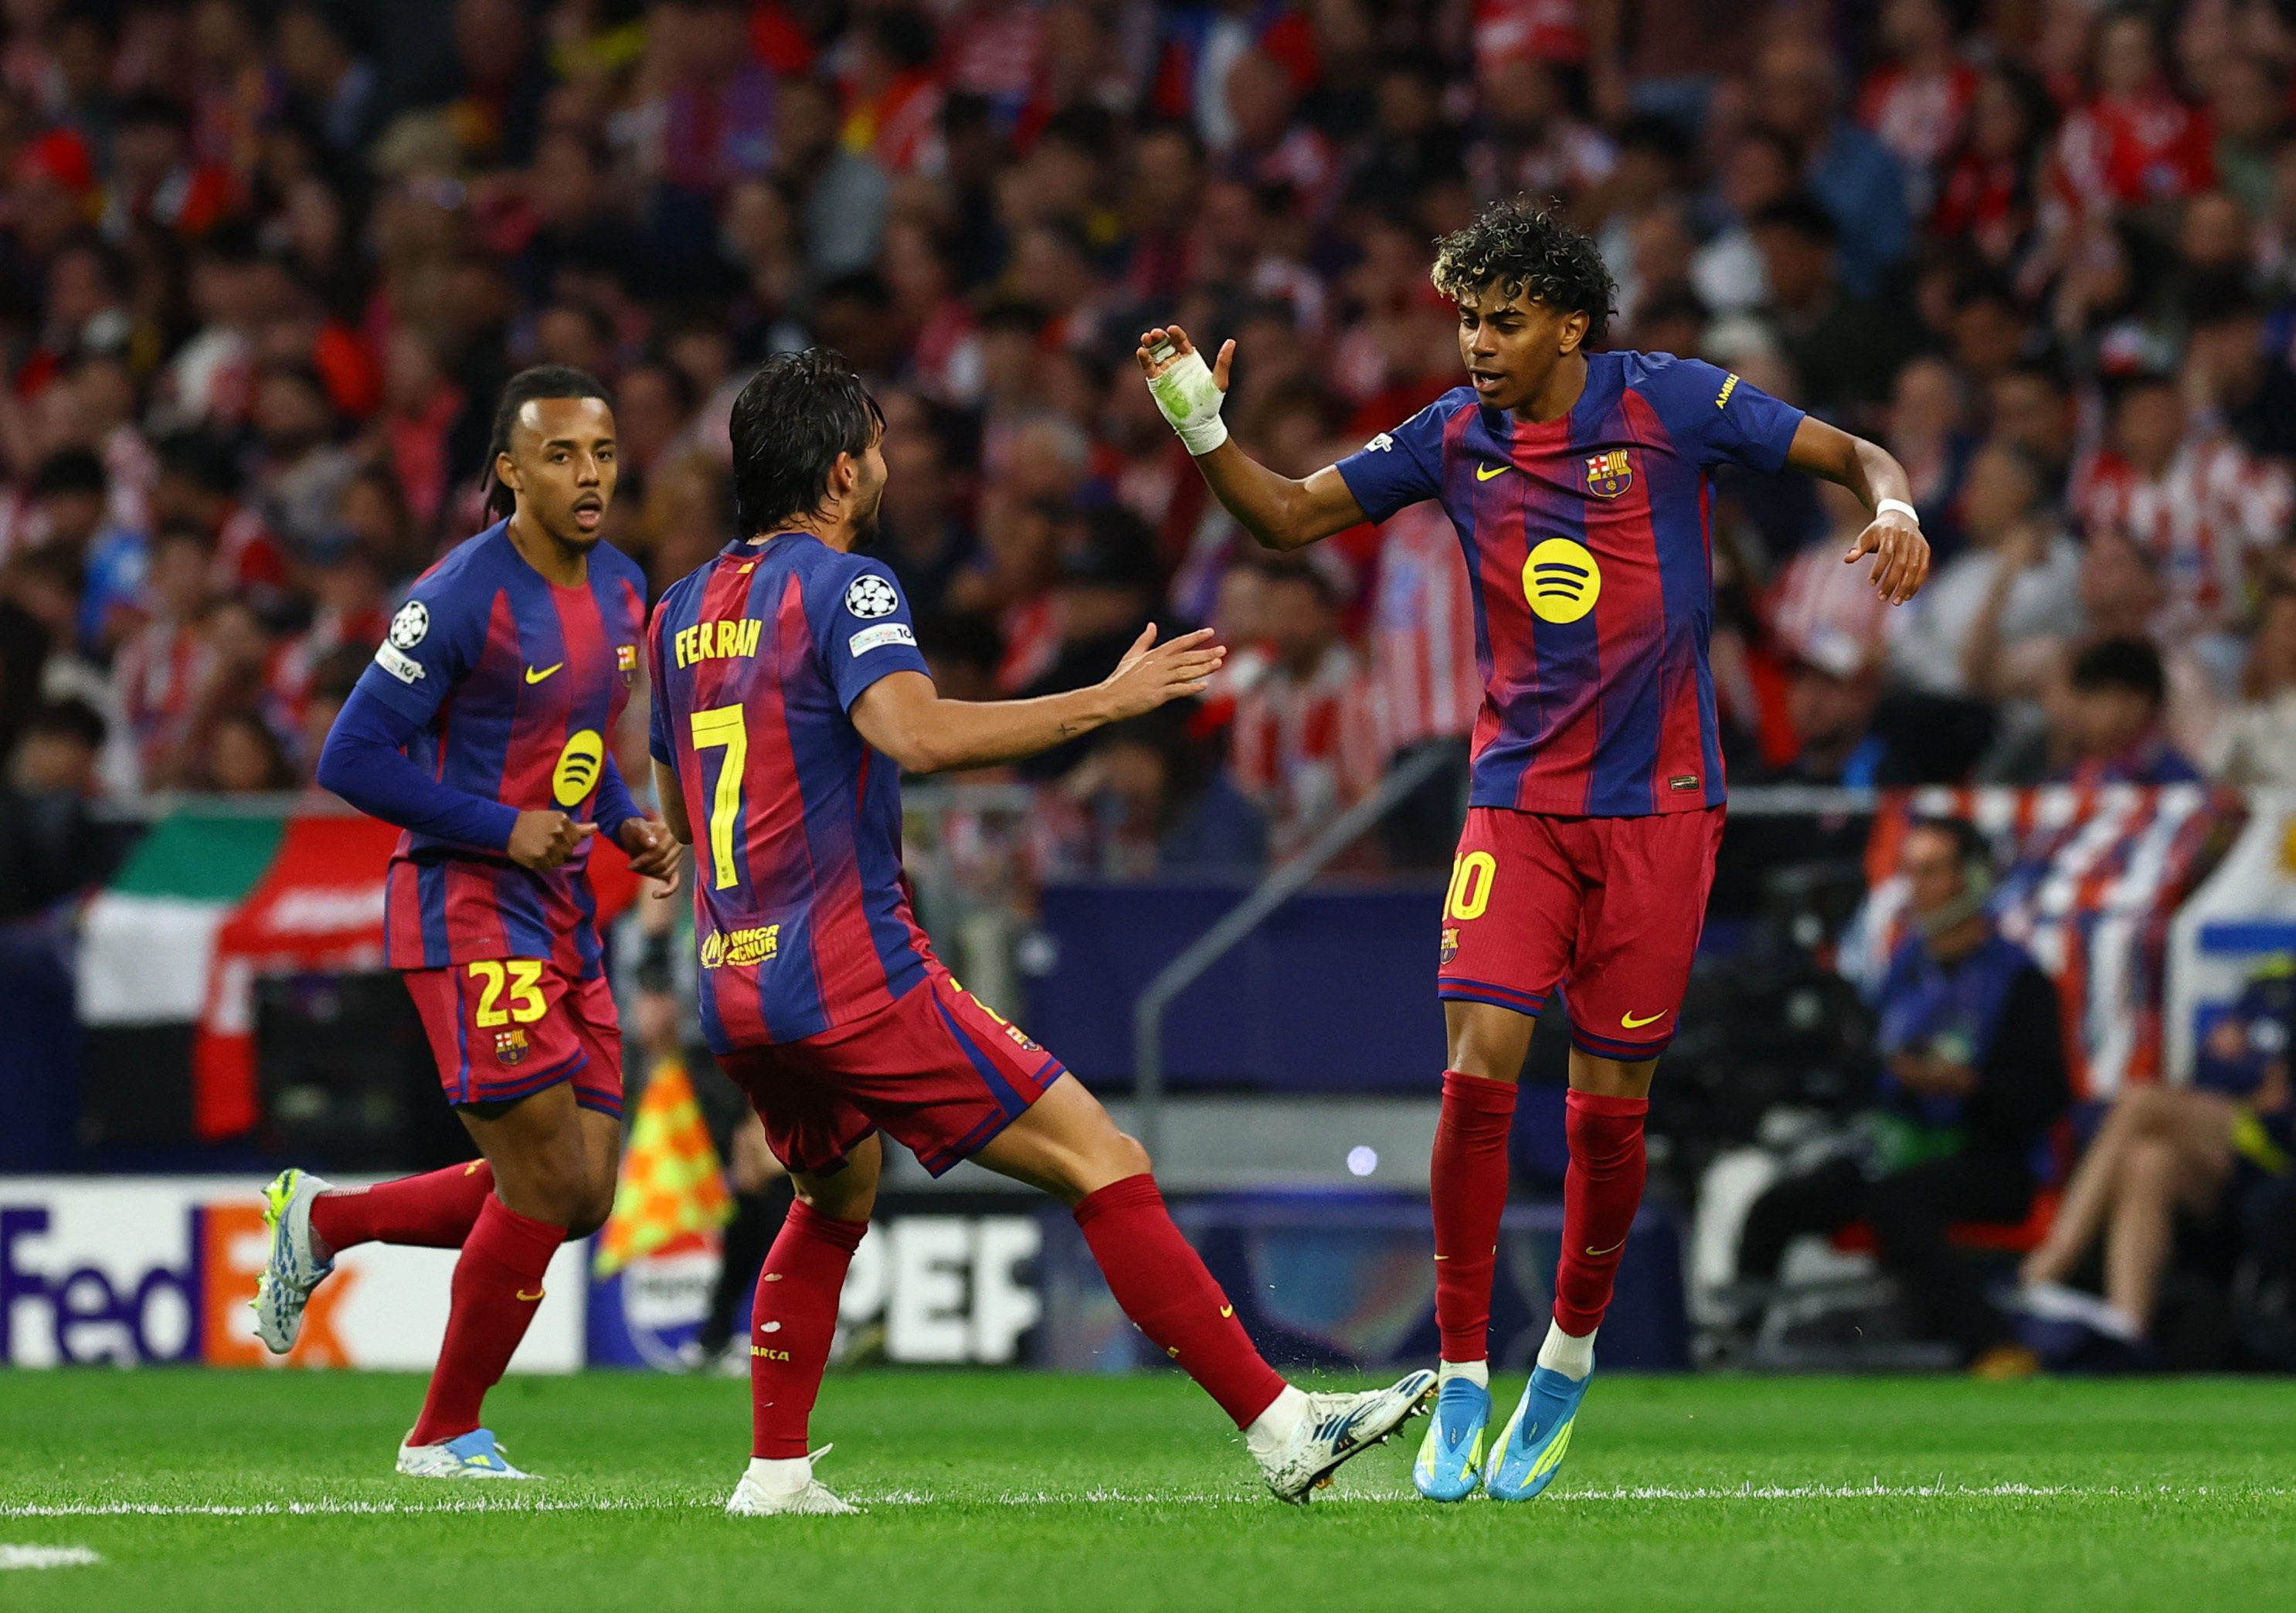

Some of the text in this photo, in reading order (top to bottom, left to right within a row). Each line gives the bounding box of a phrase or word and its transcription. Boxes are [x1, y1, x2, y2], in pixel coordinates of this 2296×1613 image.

[675, 618, 763, 670] FERRAN
[690, 703, 747, 891] 7
[726, 936, 777, 961] ACNUR
[469, 960, 548, 1028] 23
